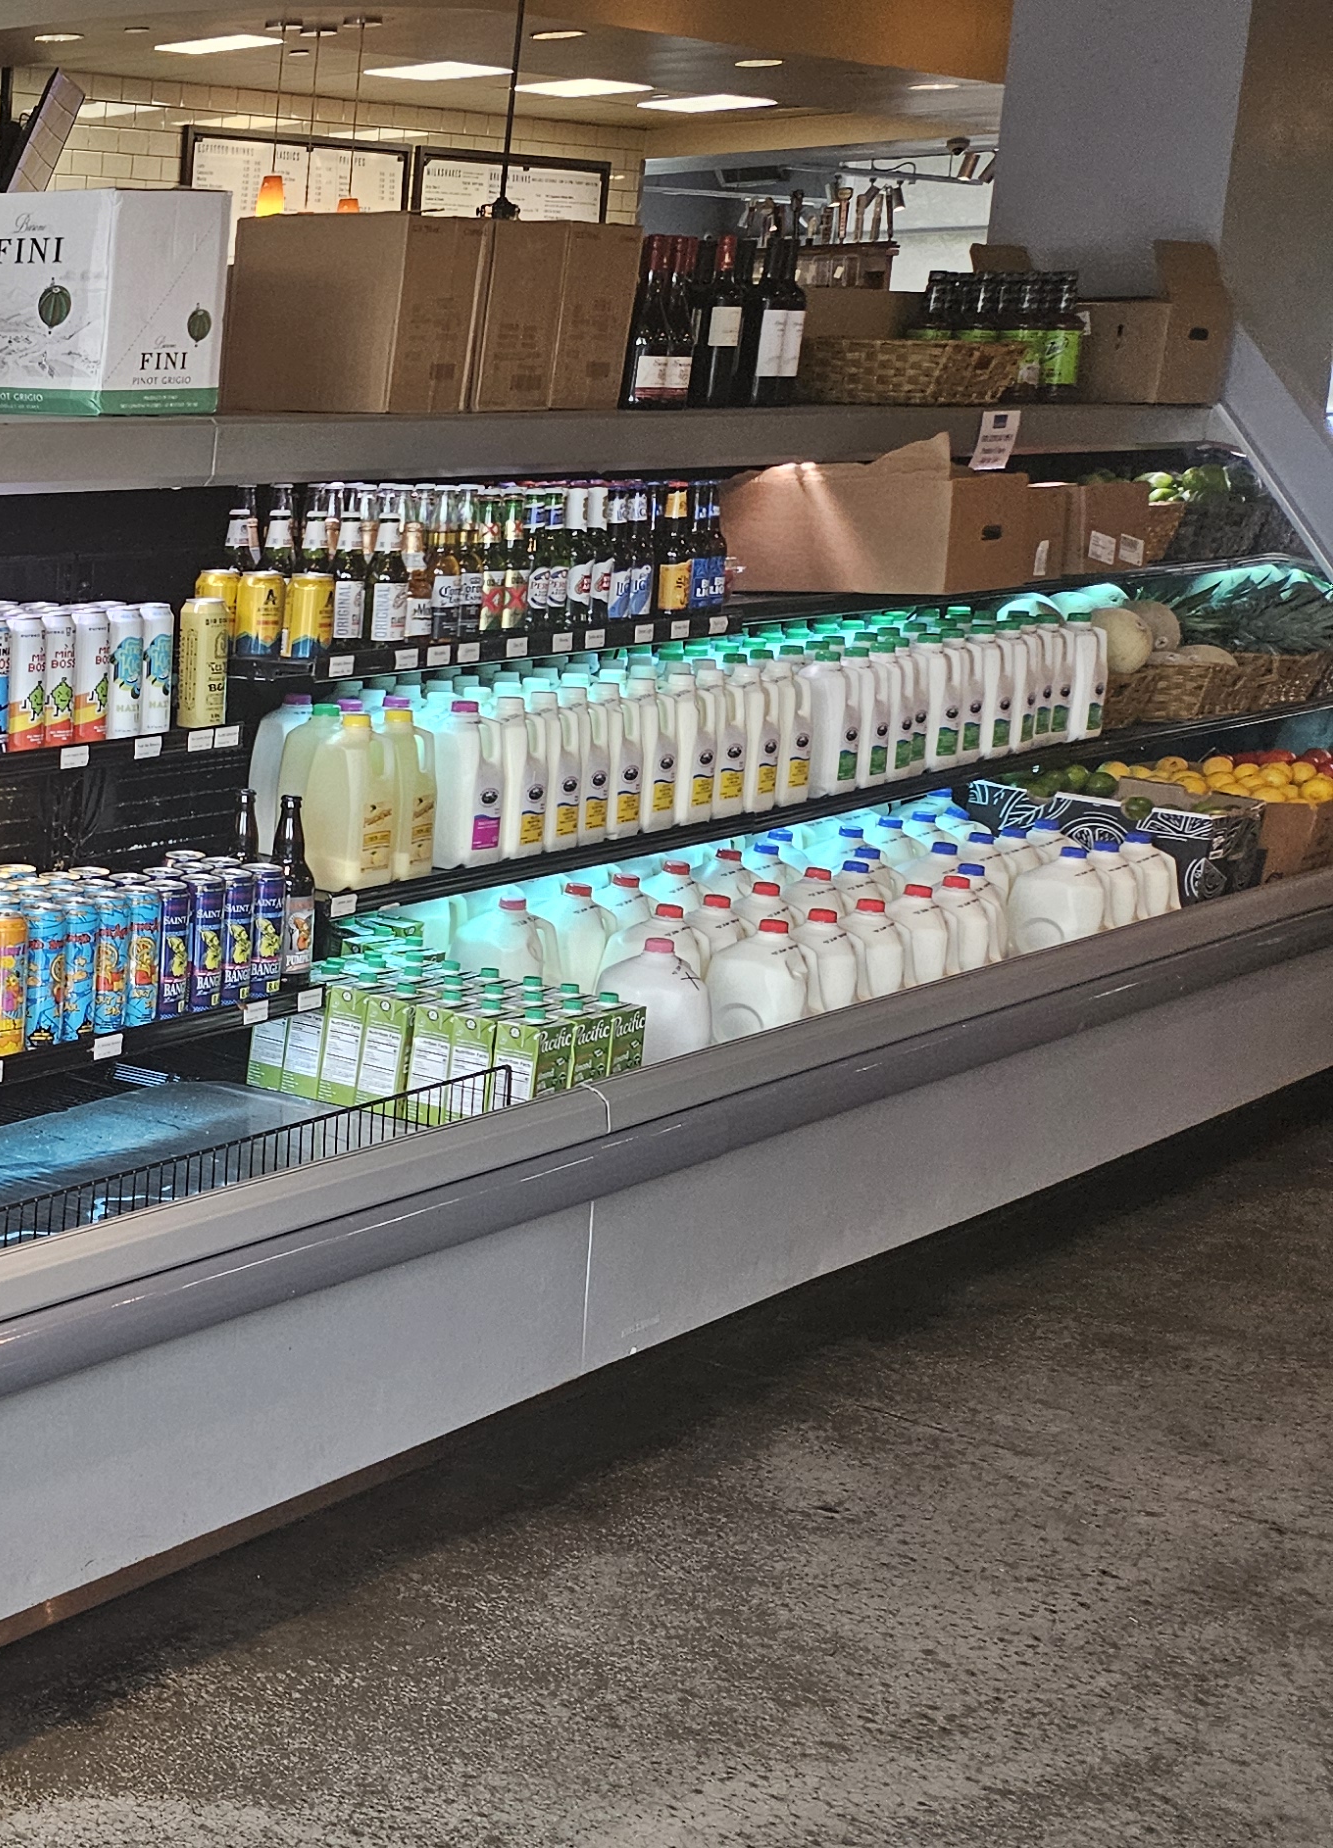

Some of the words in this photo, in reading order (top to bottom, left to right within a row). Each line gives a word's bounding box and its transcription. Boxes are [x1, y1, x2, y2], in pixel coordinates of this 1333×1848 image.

[140, 352, 187, 370] FINI
[133, 376, 158, 385] PINOT
[162, 376, 191, 384] GRIGIO
[336, 584, 351, 636] ORIGINAL
[375, 586, 391, 638] ORIGINAL
[197, 908, 220, 919] SAINT
[539, 1025, 571, 1052] Pacific
[574, 1019, 610, 1046] Pacific
[612, 1014, 646, 1040] Pacific
